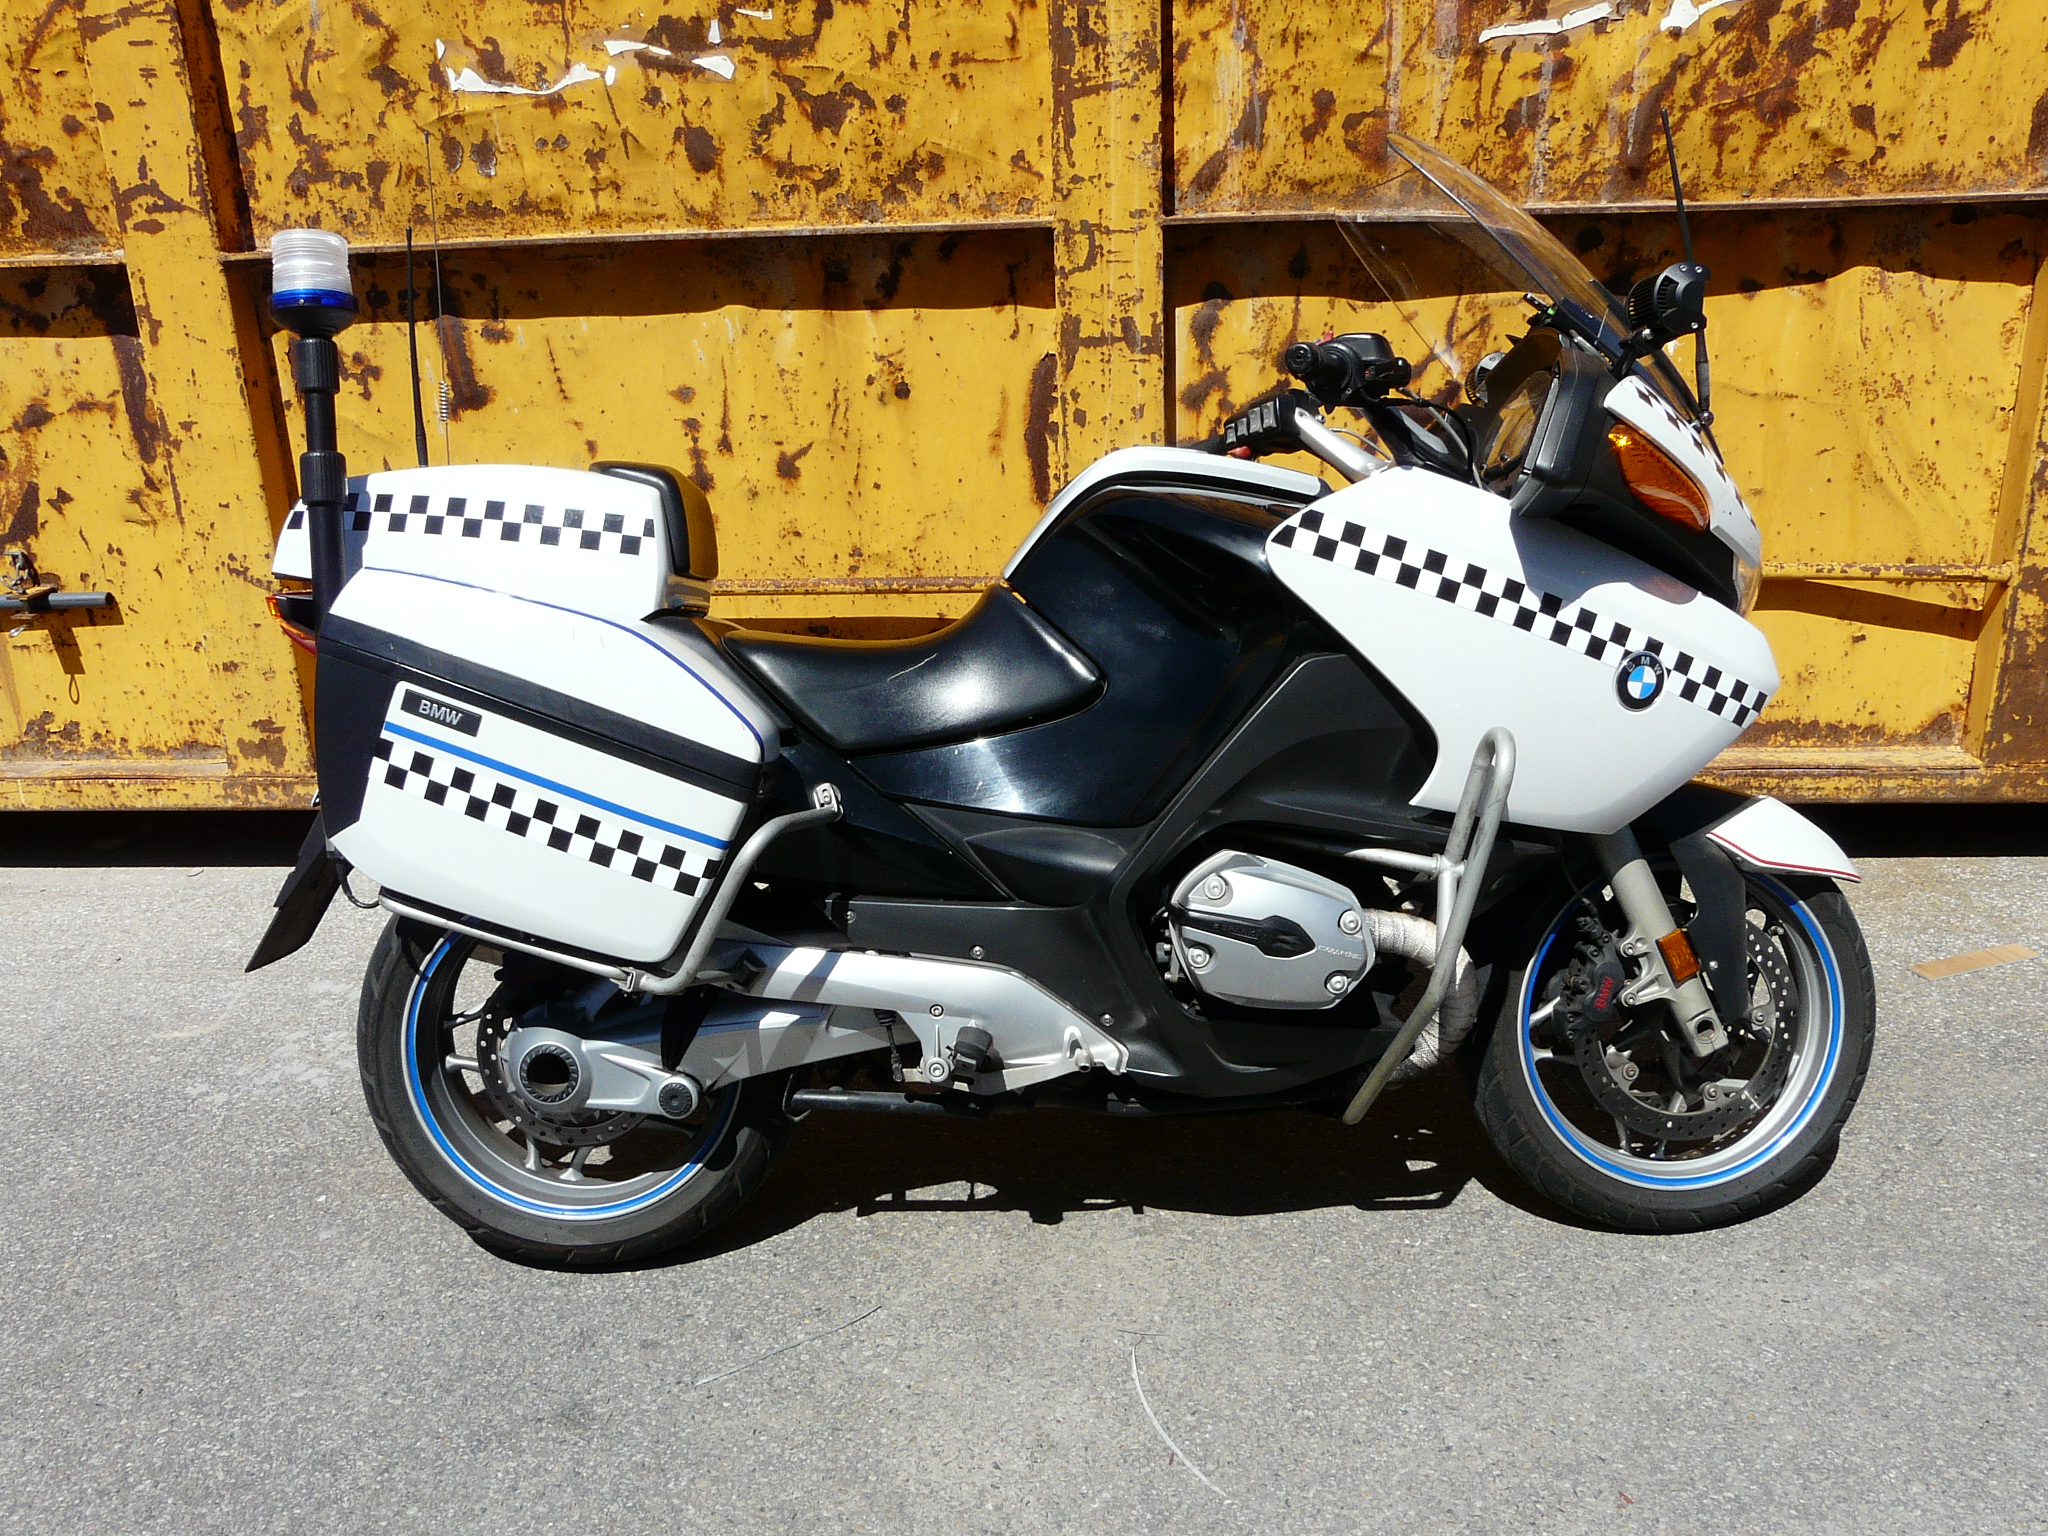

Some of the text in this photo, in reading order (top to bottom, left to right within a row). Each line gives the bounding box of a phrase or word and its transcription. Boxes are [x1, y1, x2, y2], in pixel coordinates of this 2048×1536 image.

[1625, 655, 1663, 676] BMW
[418, 699, 463, 726] BMW
[1595, 975, 1614, 1009] BMW
